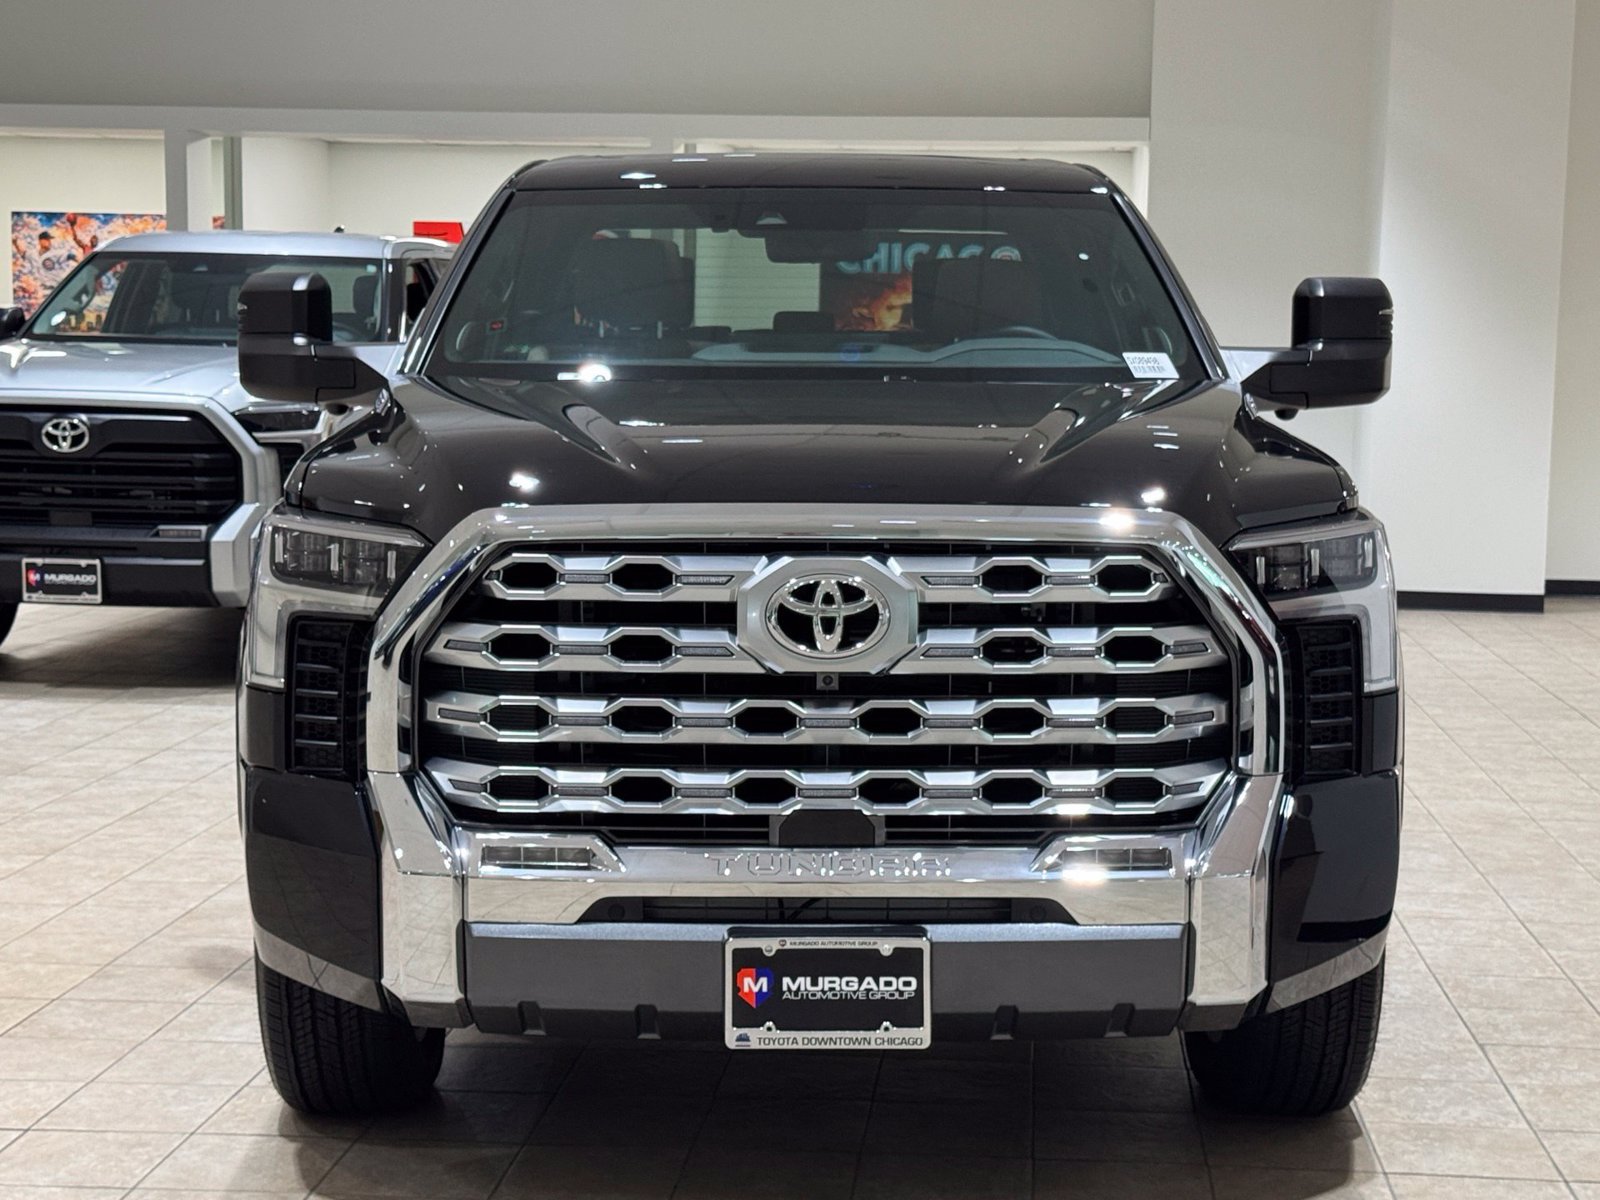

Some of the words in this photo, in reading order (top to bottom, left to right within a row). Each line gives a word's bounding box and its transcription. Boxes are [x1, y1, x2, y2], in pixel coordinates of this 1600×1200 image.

[704, 852, 951, 876] TUNDRA
[782, 976, 917, 992] MURGADO
[782, 991, 867, 1000] AUTOMOTIVE
[868, 991, 915, 1000] GROUP
[757, 1036, 799, 1046] TOYOTA
[801, 1036, 872, 1046] DOWNTOWN
[874, 1036, 923, 1046] CHICAGO
